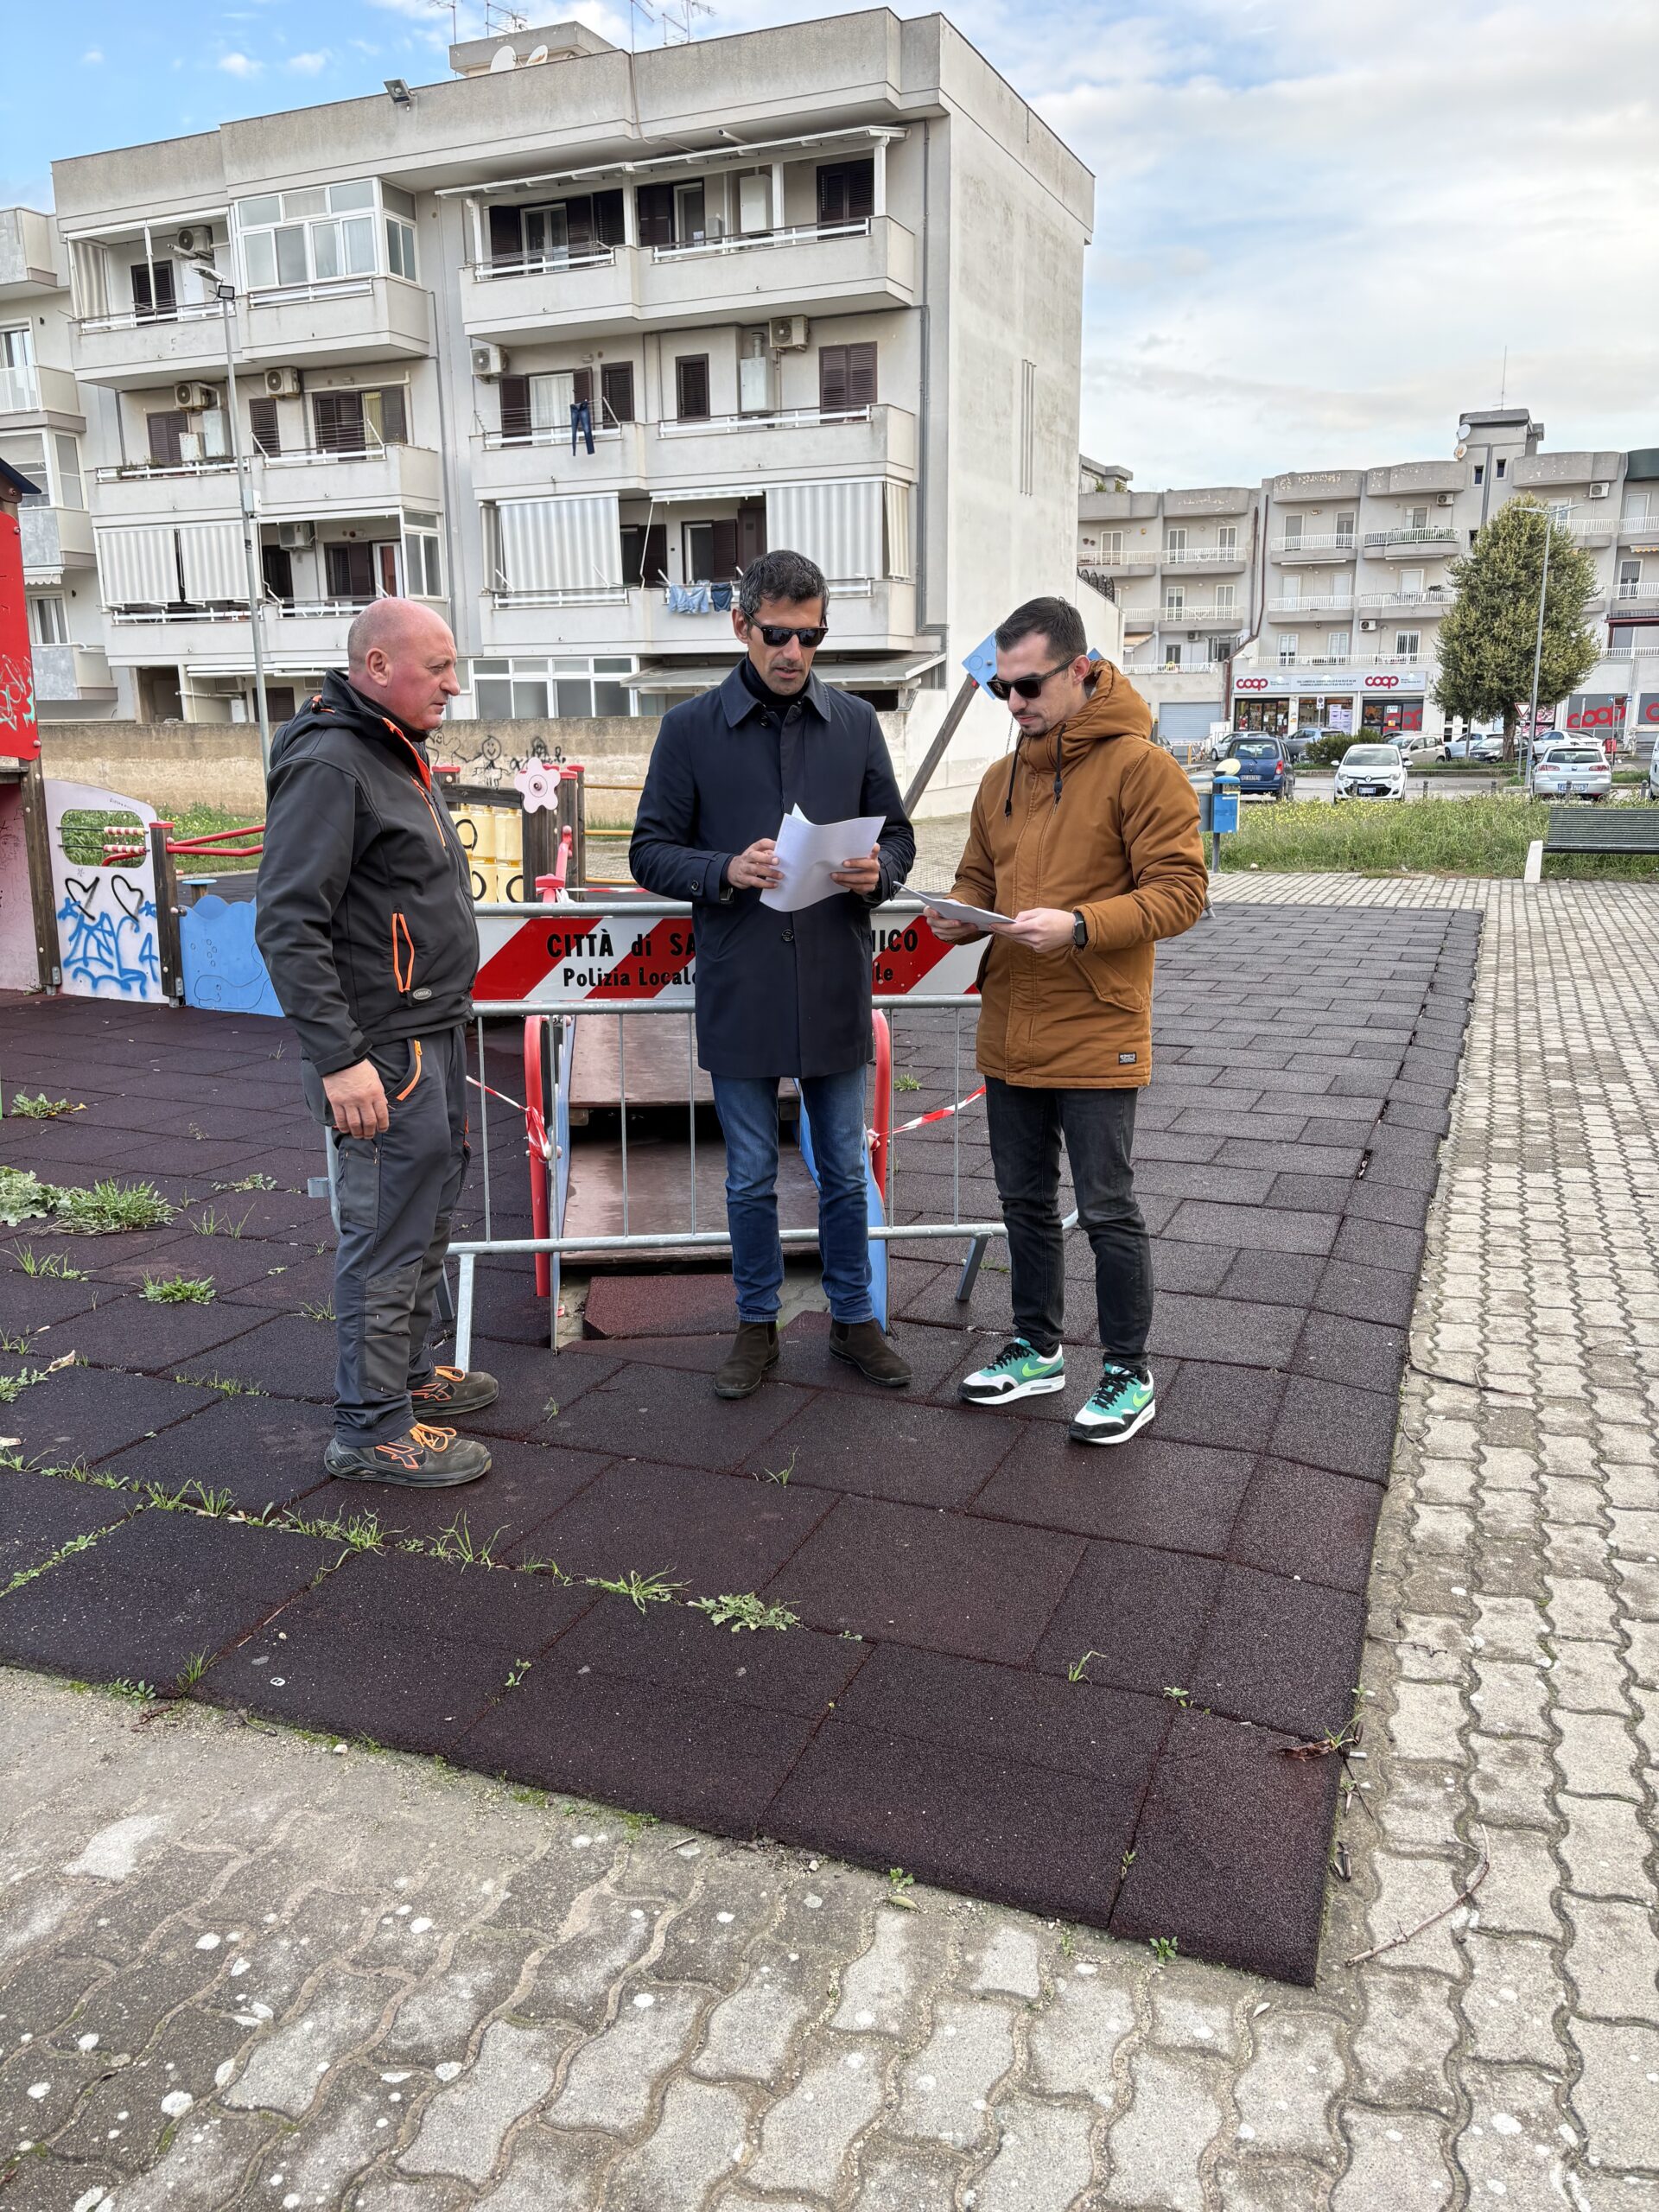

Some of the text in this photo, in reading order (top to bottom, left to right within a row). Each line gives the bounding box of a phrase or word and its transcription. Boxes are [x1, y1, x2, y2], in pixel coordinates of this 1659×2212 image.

[1236, 678, 1268, 691] coop
[1365, 676, 1399, 690] coop
[1567, 704, 1626, 728] coop
[547, 928, 614, 957] CITTÀ
[631, 933, 652, 957] di
[563, 967, 631, 987] Polizia
